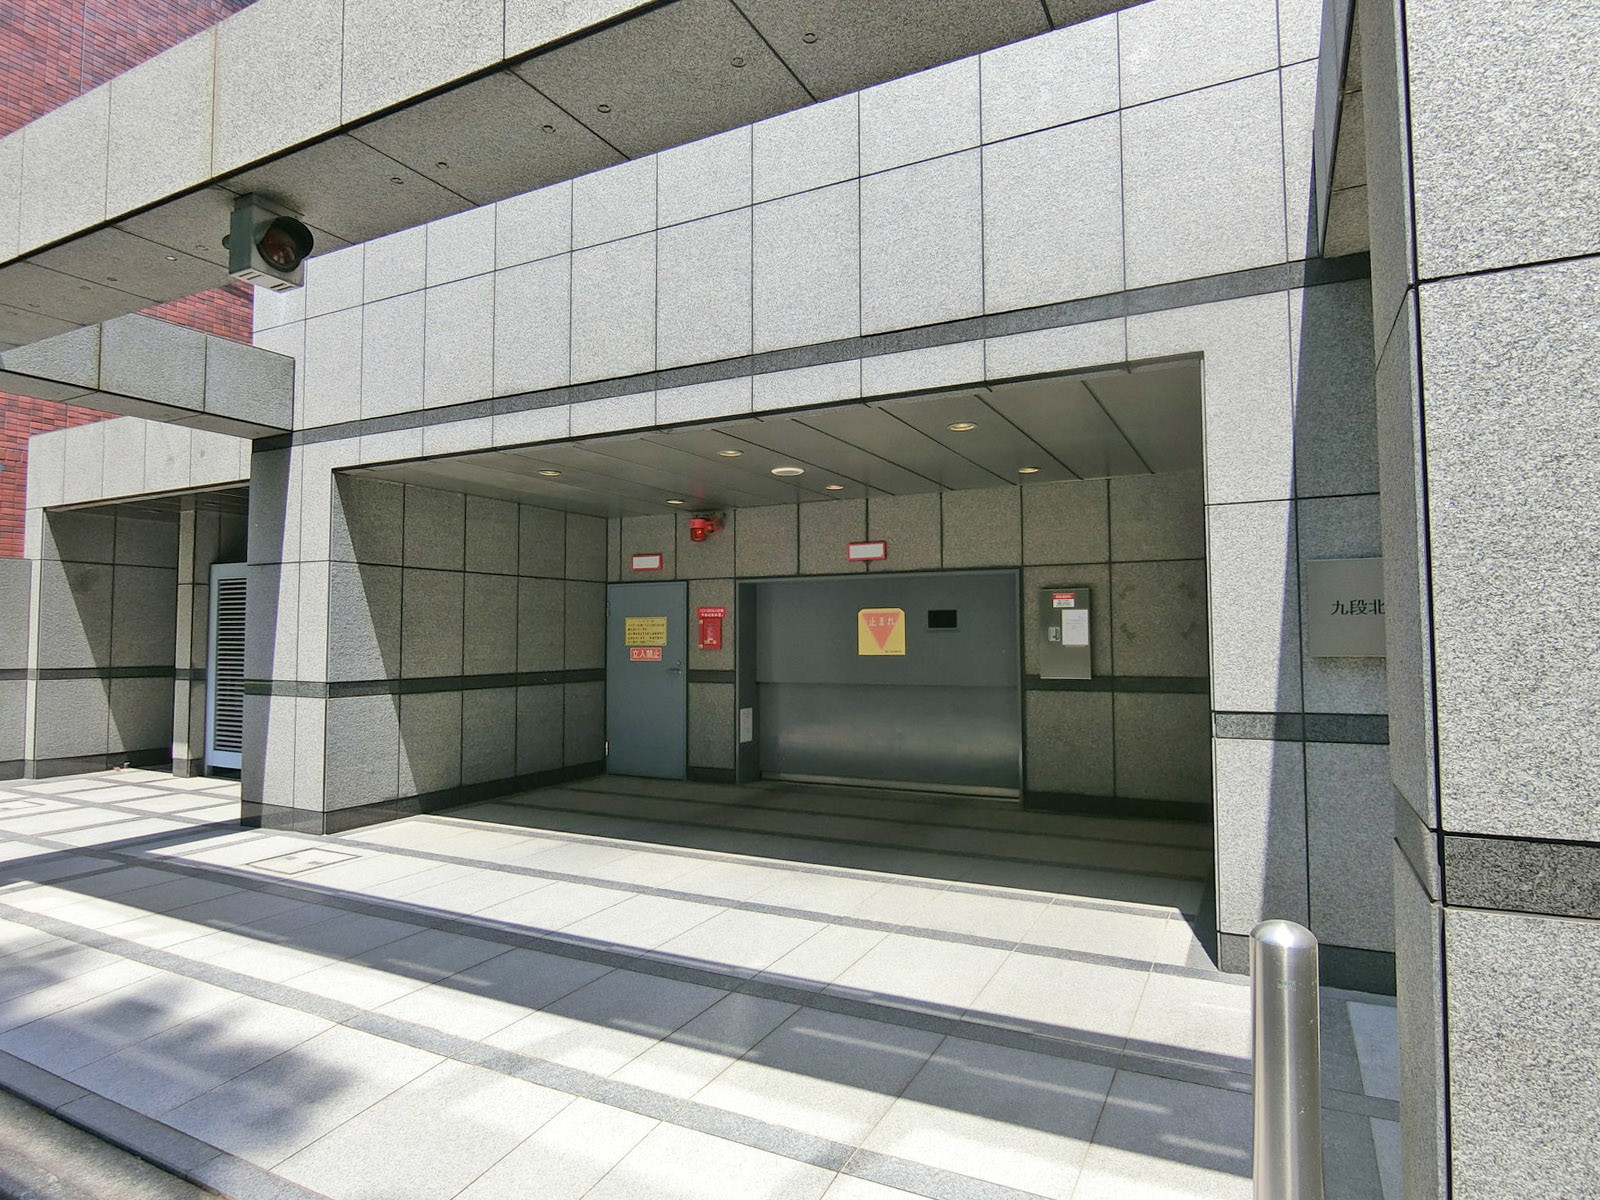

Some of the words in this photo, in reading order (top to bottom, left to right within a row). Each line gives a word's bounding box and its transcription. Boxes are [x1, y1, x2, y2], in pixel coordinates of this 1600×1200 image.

[1331, 600, 1385, 615] 九段北
[869, 616, 895, 626] 止まれ
[632, 650, 660, 658] 立入禁止
